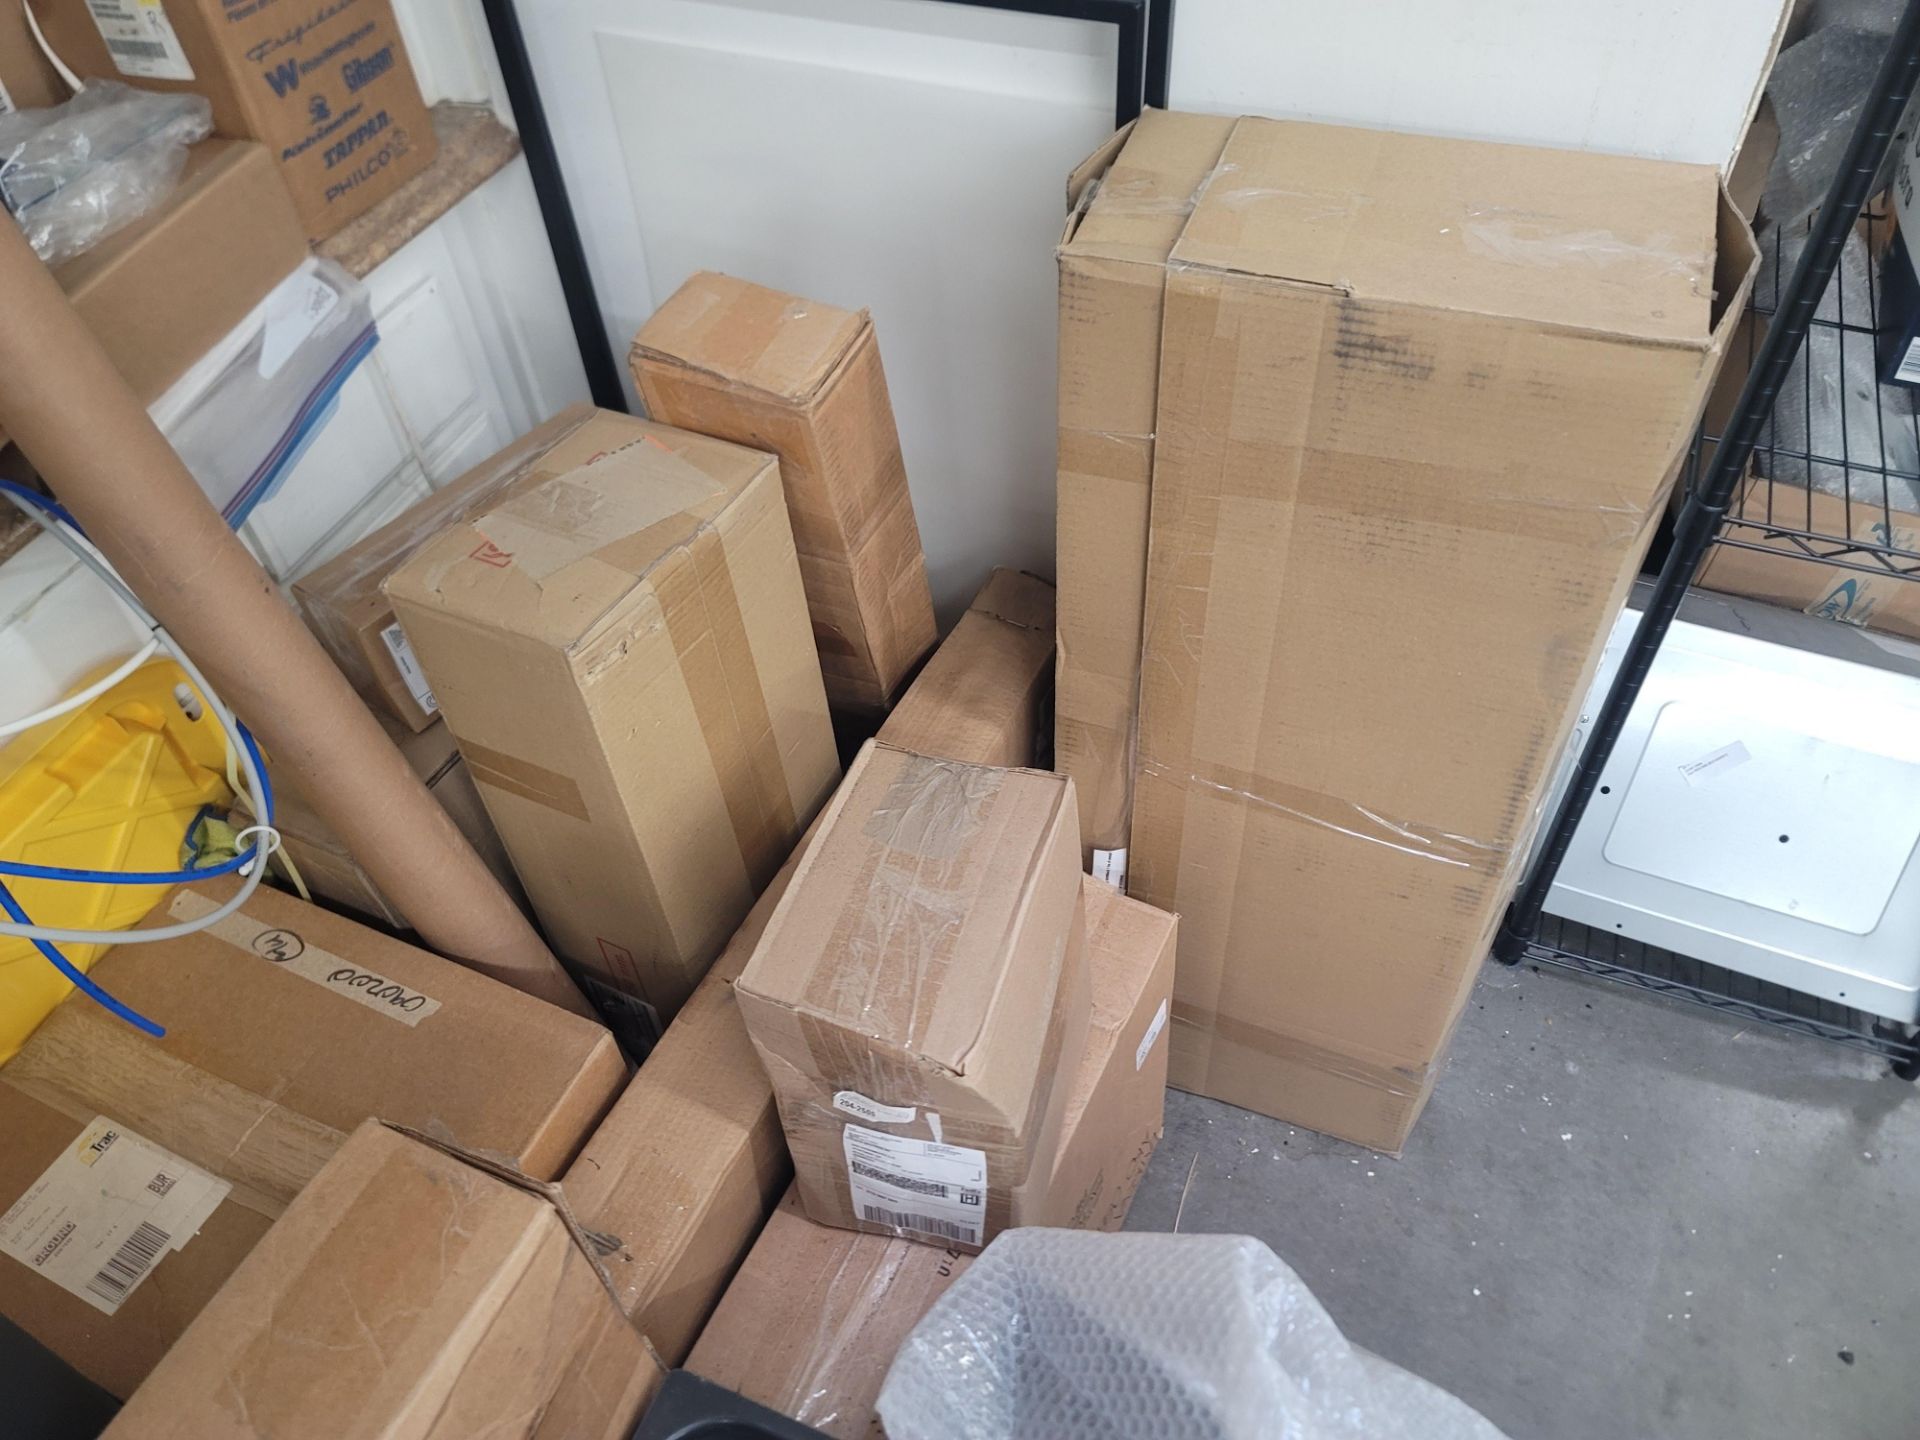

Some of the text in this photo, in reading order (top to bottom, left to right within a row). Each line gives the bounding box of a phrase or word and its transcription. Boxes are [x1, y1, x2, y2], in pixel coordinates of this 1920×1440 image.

[325, 149, 391, 202] PHILCO
[148, 1174, 171, 1194] BUR
[33, 1221, 77, 1267] GROUND
